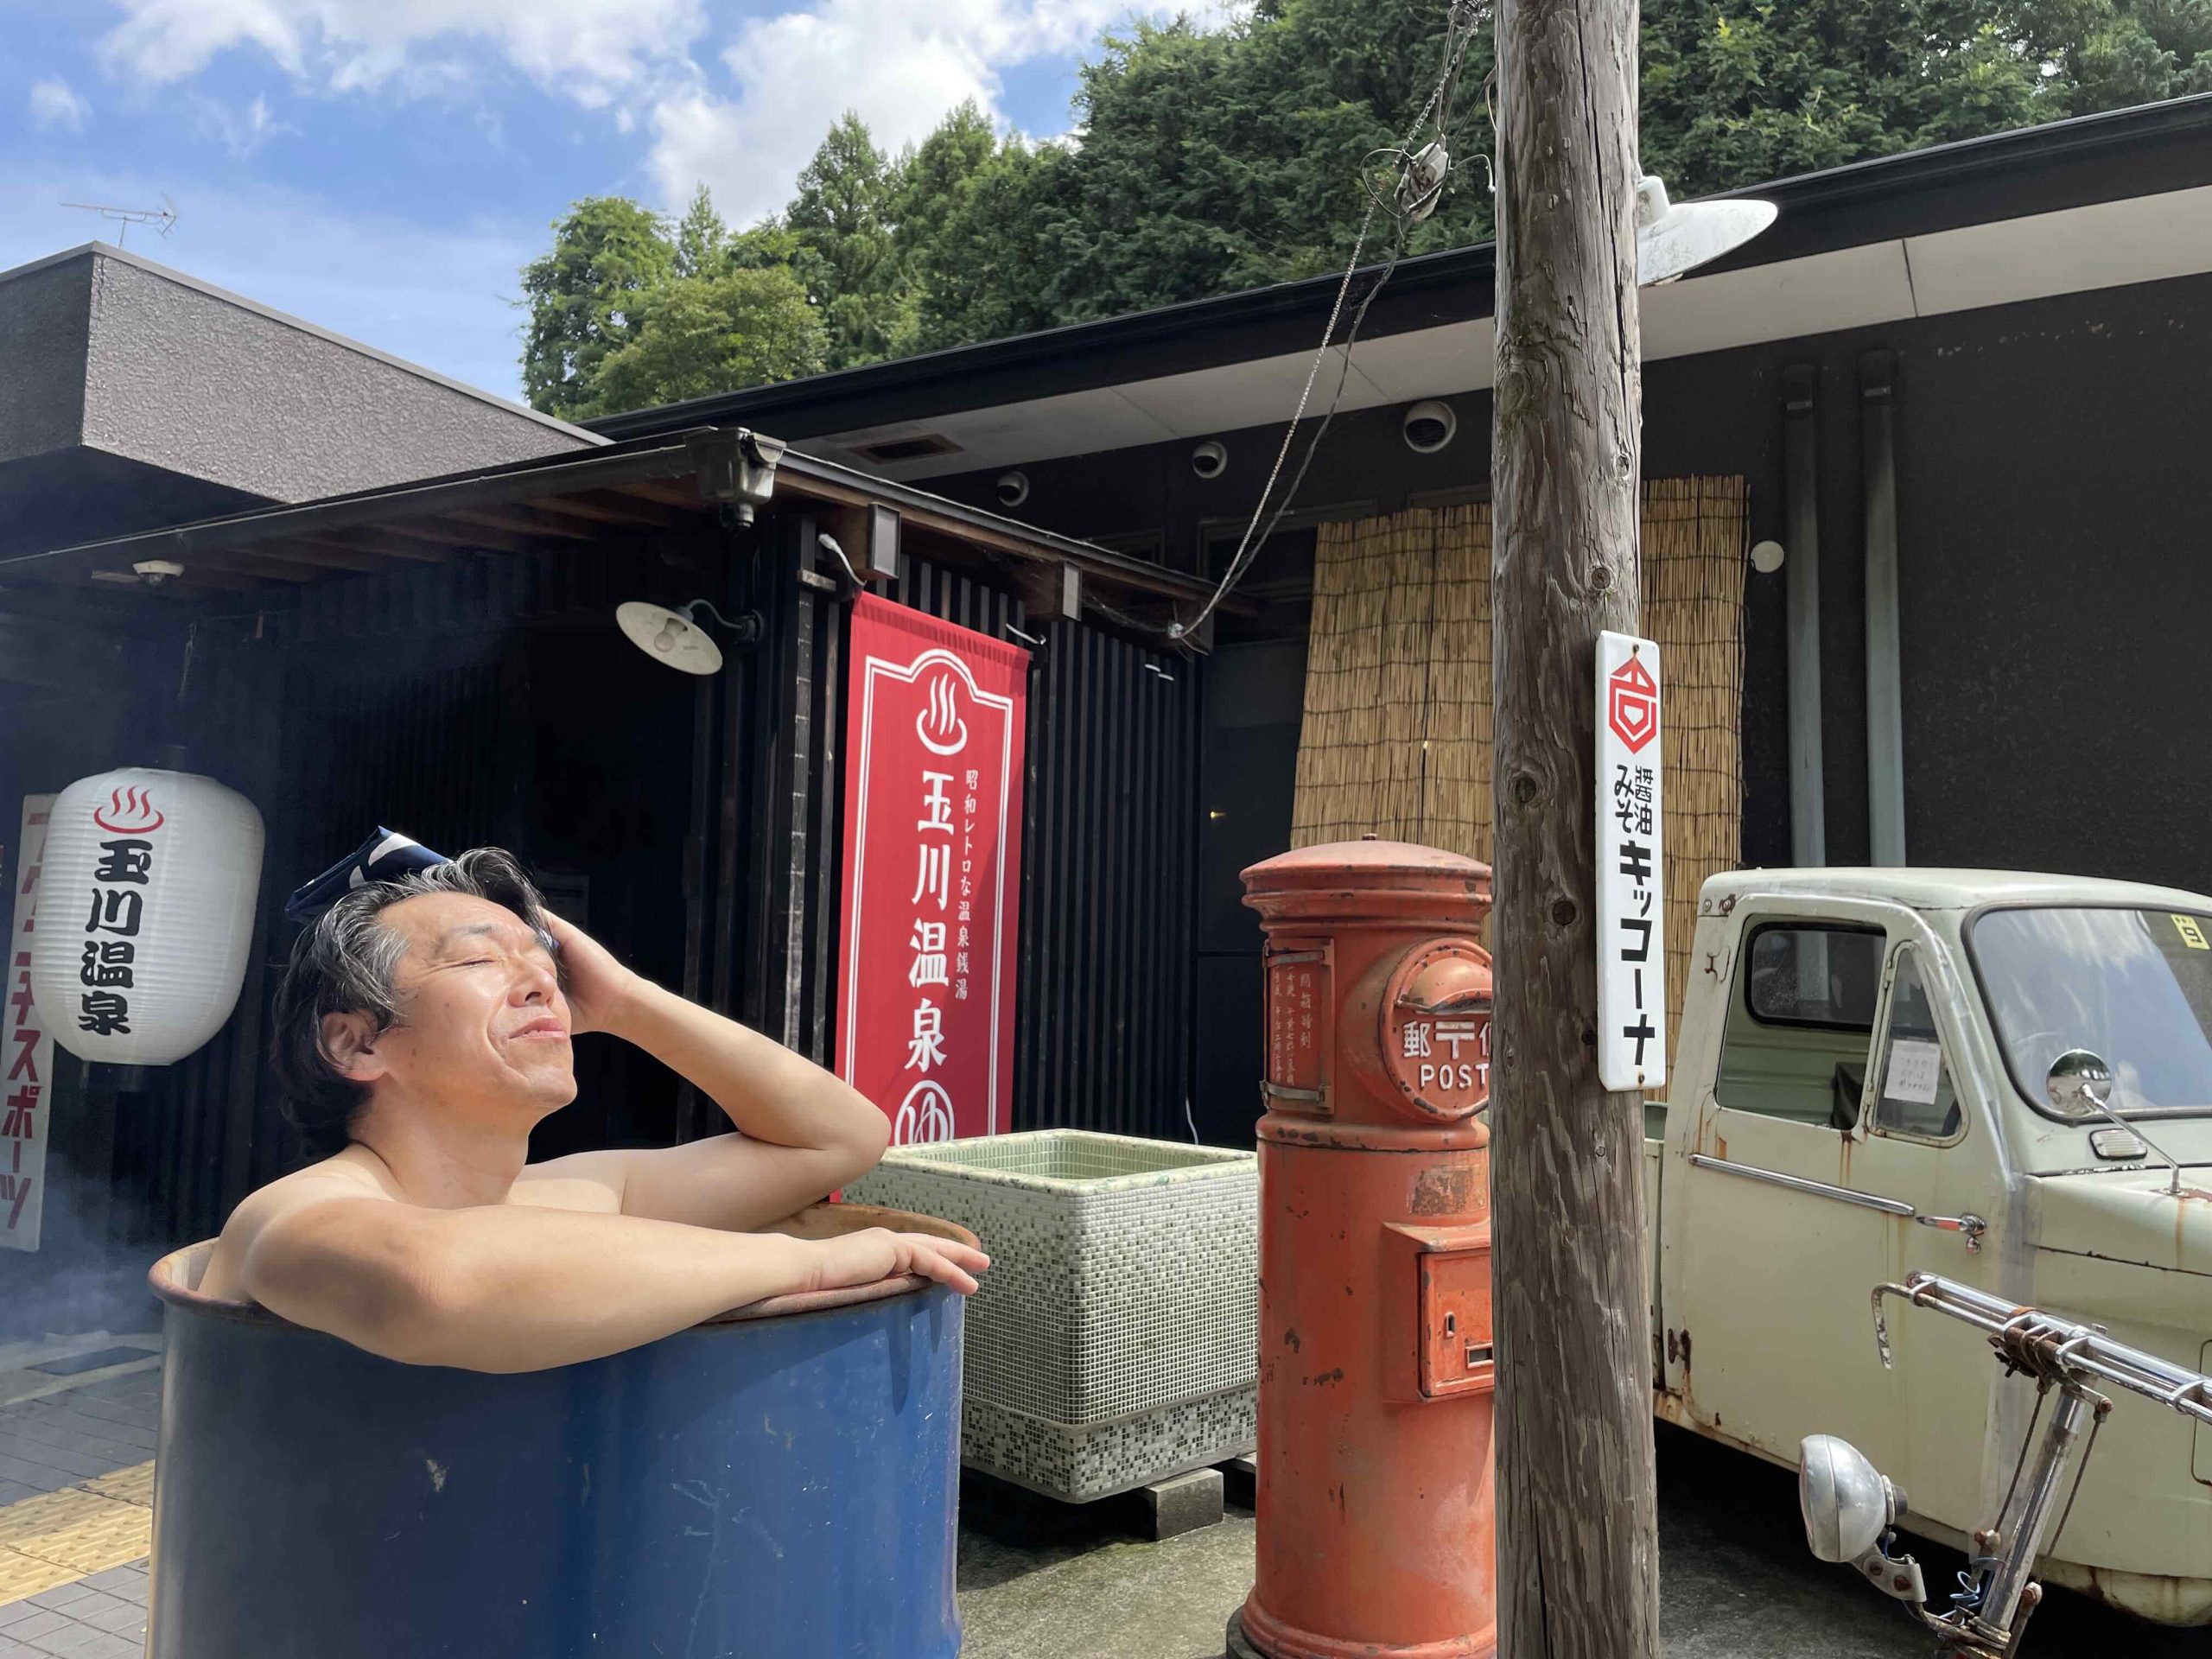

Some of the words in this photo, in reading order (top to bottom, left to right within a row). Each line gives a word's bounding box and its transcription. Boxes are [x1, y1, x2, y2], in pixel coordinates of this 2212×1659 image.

[955, 769, 979, 1000] 昭和レトロな温泉銭湯
[1614, 764, 1635, 834] みそ
[78, 839, 153, 1036] 玉川温泉
[904, 770, 955, 1073] 玉川温泉
[1619, 840, 1656, 1066] キッコーナ
[1420, 1064, 1490, 1090] POST
